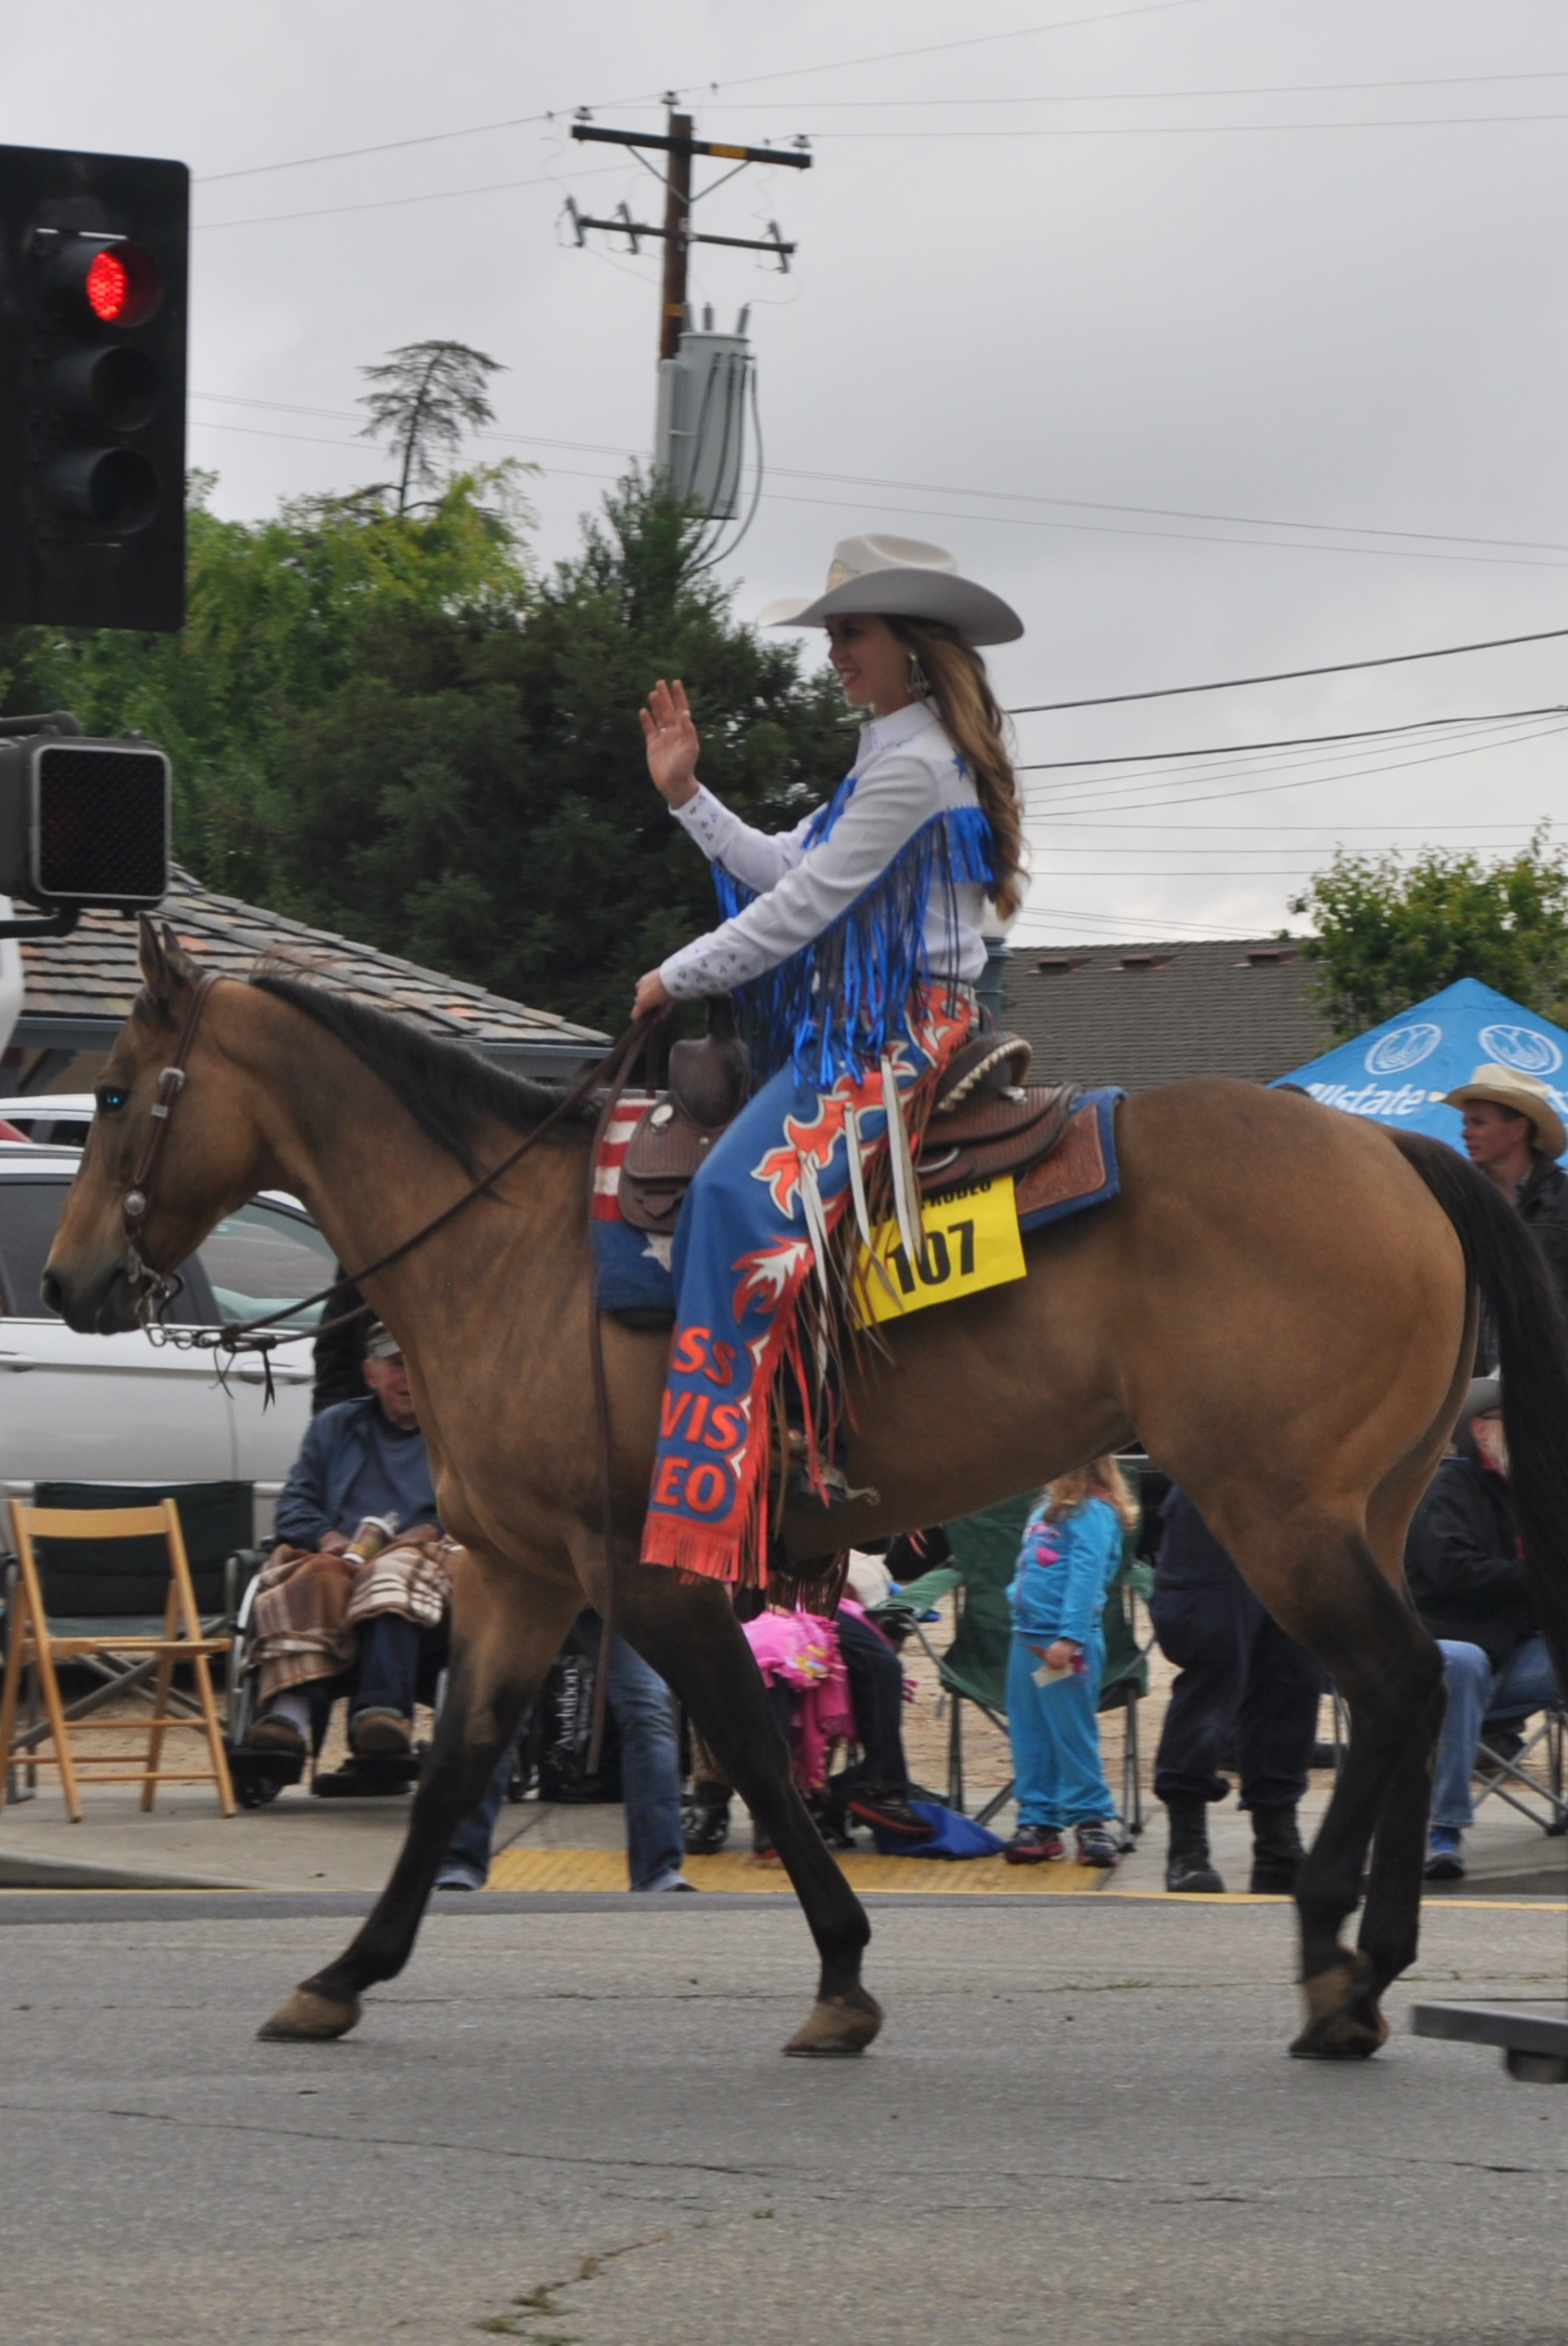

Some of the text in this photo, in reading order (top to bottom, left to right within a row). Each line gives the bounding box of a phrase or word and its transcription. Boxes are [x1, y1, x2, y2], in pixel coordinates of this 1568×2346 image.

[1305, 1082, 1427, 1116] Allstate
[886, 1218, 975, 1295] 107
[661, 1389, 742, 1451] VIS
[555, 1669, 579, 1751] Audubon
